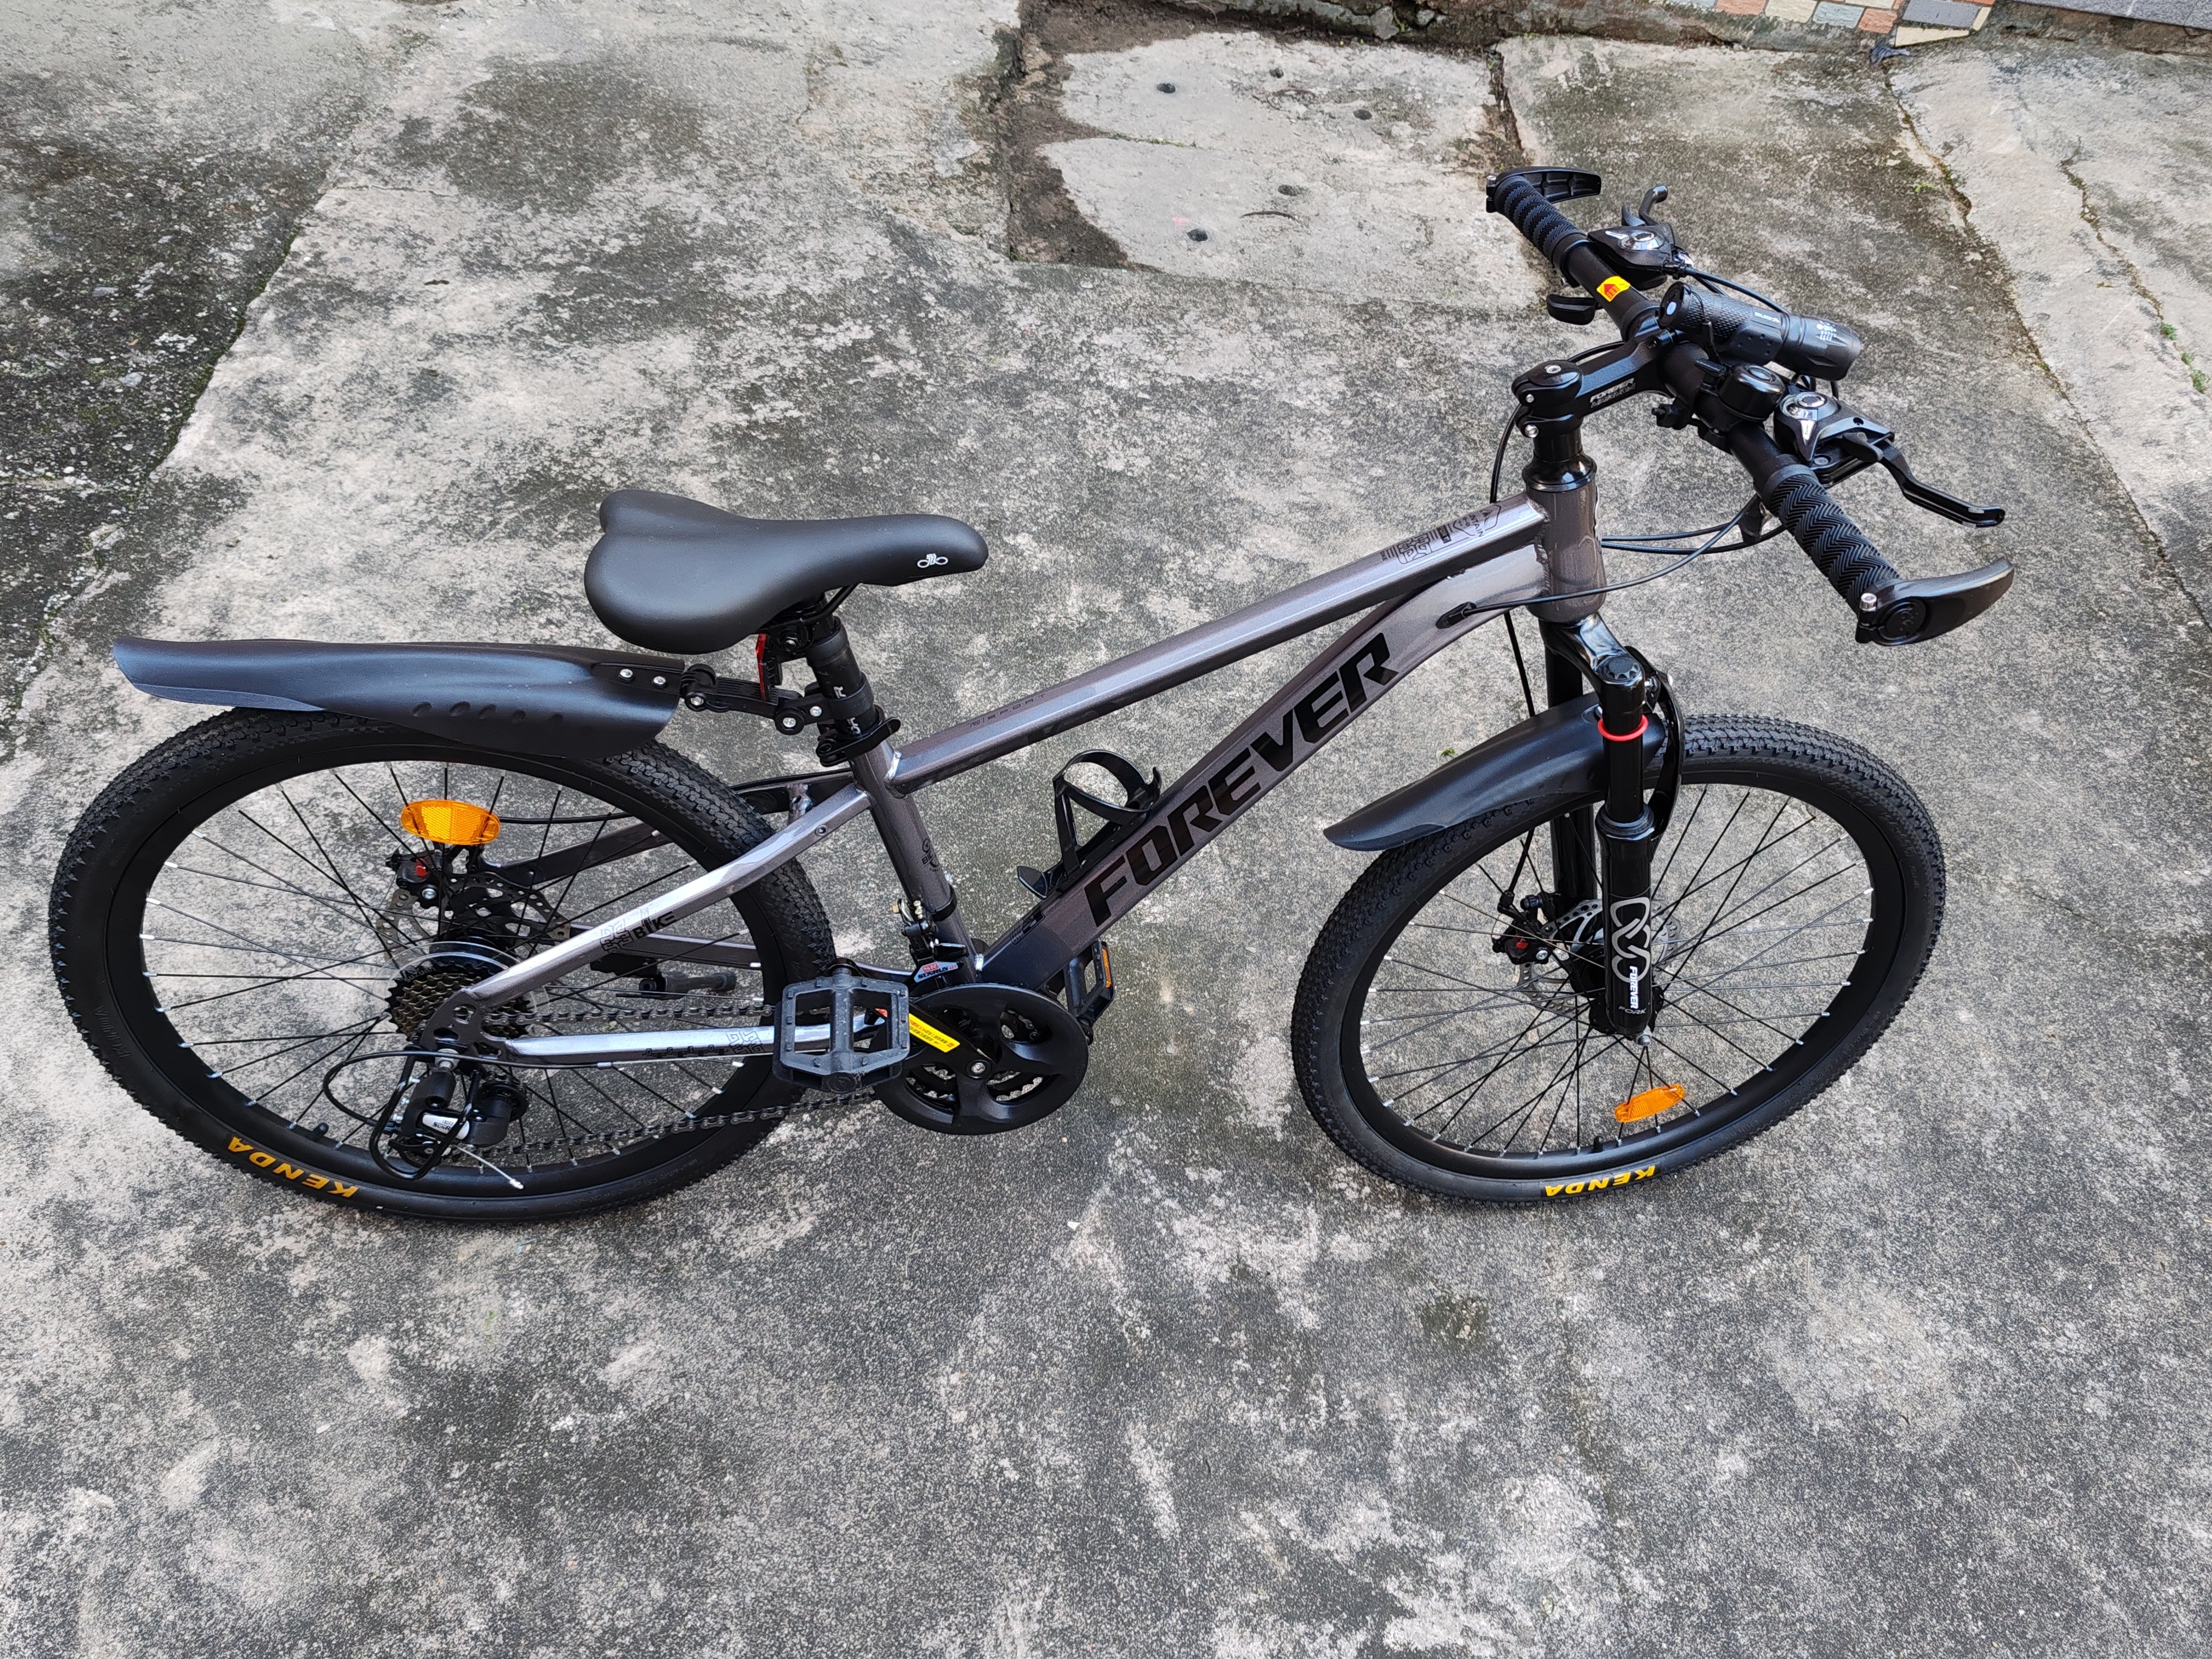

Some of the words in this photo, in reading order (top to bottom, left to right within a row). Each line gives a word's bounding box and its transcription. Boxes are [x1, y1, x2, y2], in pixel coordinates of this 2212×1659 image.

[1084, 632, 1399, 927] FOREVER
[632, 911, 677, 939] BIKE
[1630, 966, 1638, 1009] FOREVER
[1618, 1005, 1647, 1015] FORK
[228, 1136, 359, 1198] KENDA
[1545, 1165, 1656, 1197] KENDA
